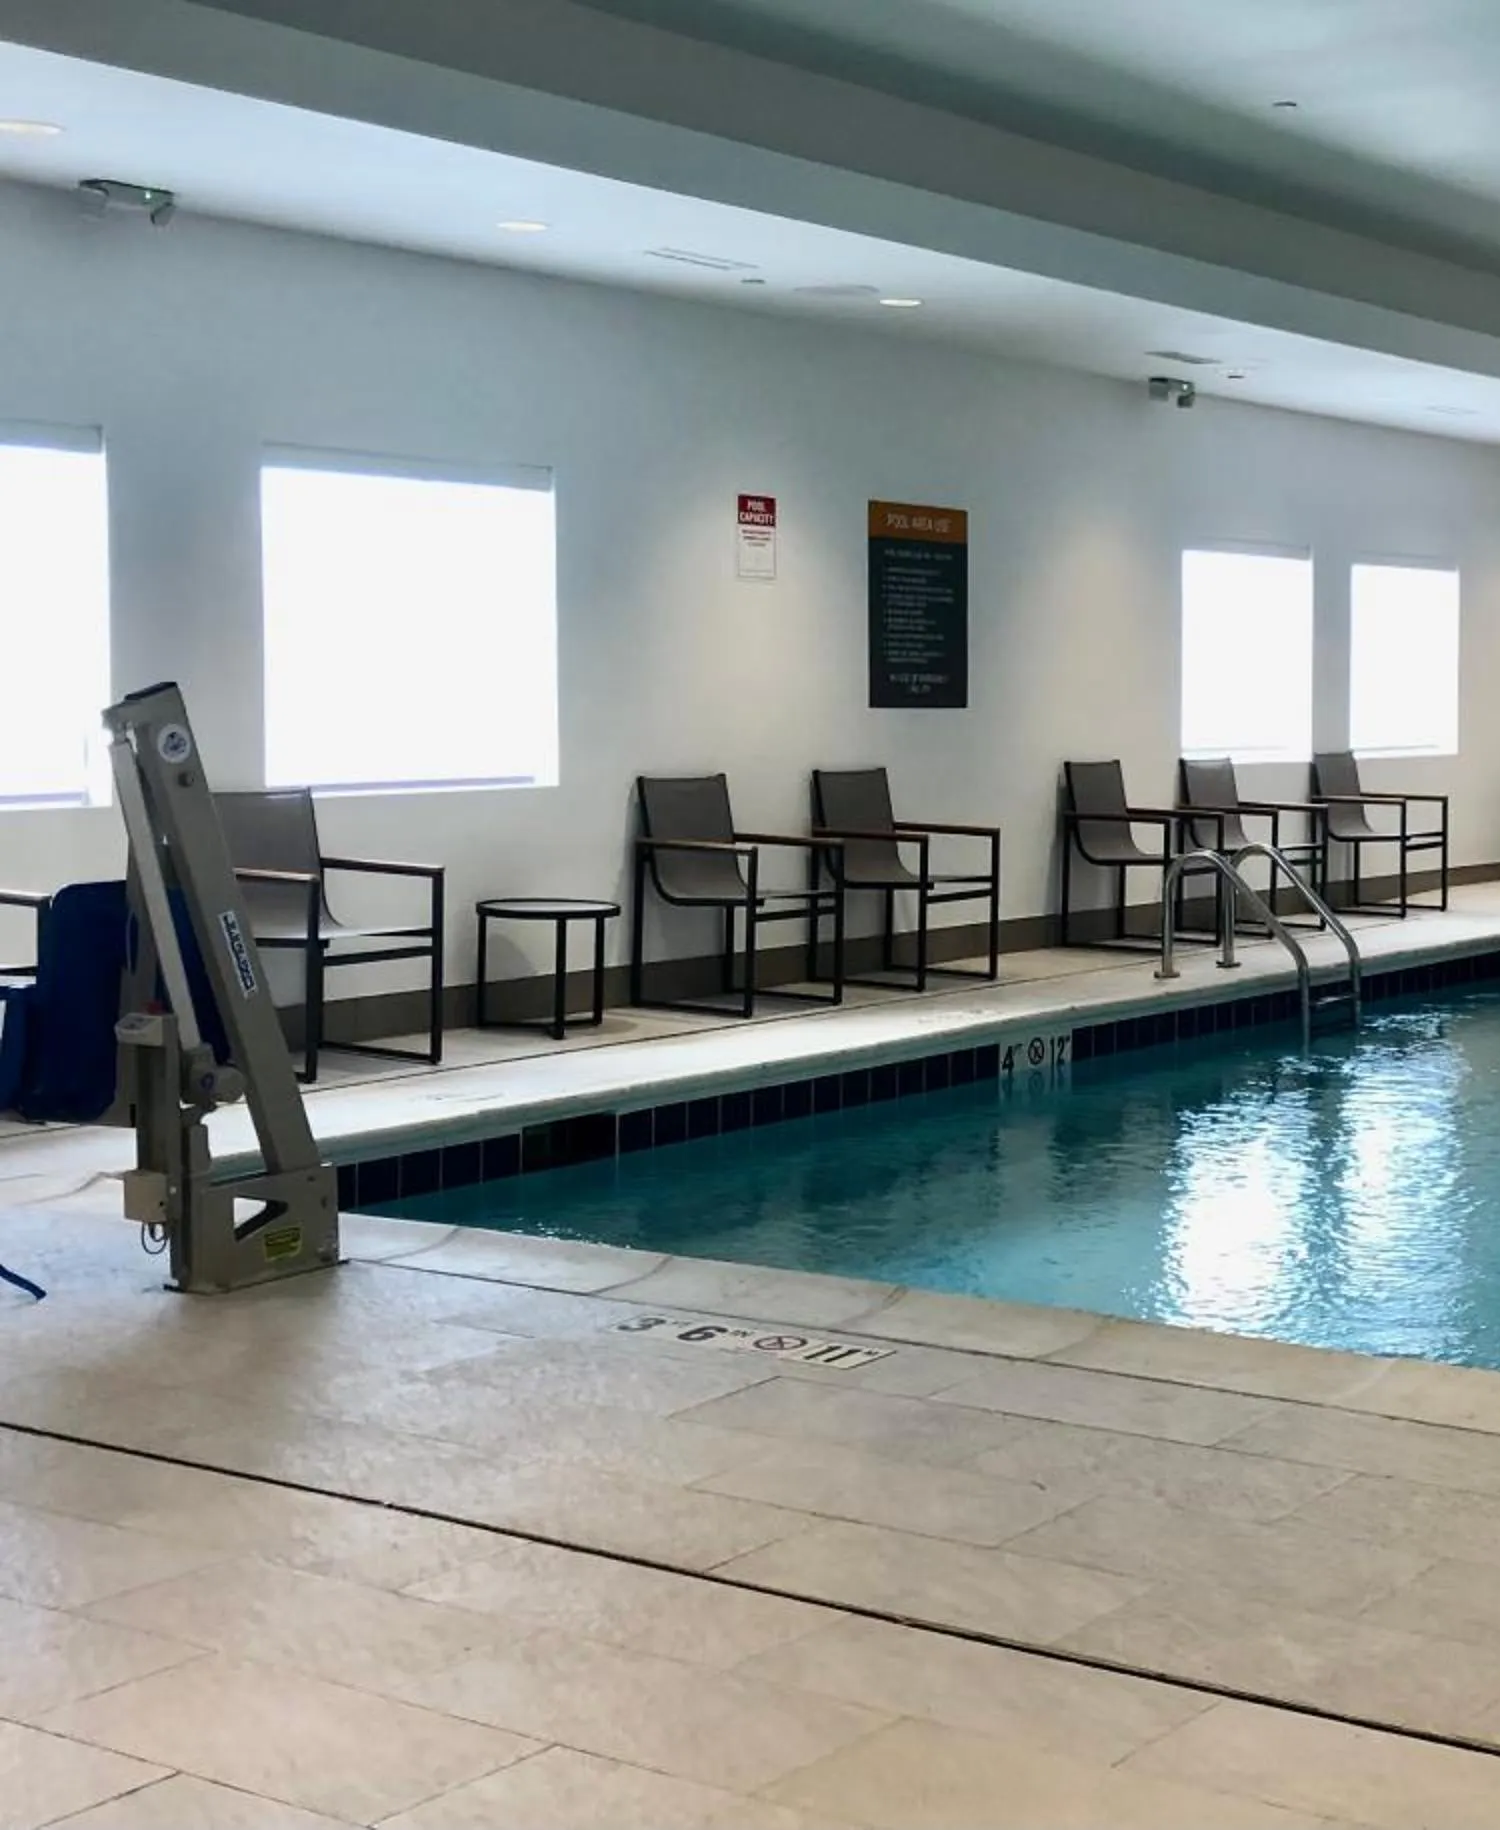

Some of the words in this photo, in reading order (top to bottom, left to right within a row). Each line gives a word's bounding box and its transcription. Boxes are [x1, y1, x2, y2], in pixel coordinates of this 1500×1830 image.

[747, 500, 766, 512] POOL
[740, 511, 775, 525] CAPACITY
[886, 512, 909, 530] POOL
